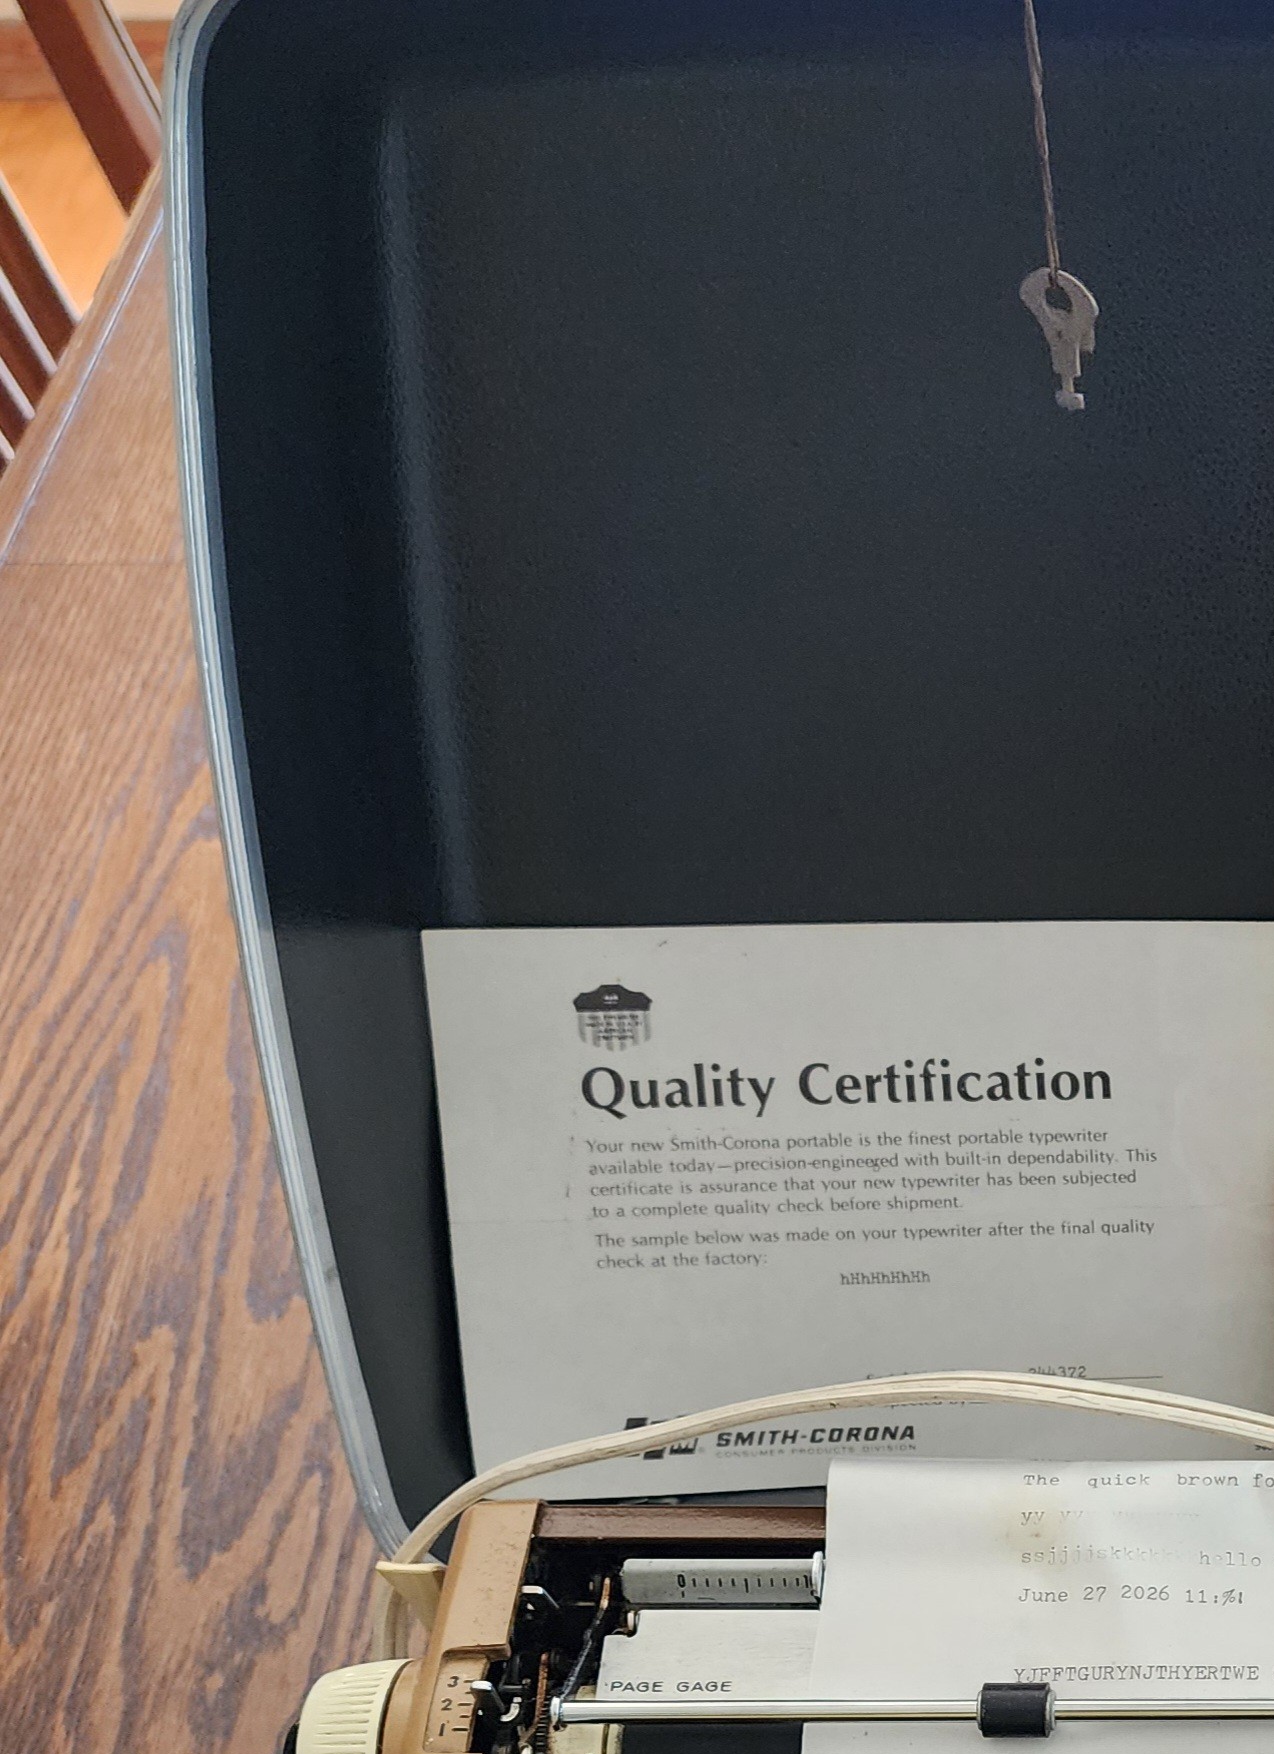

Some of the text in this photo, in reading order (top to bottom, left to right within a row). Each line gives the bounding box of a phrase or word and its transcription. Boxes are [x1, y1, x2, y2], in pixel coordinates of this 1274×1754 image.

[582, 1058, 1111, 1119] Quality Certification
[584, 1128, 1109, 1154] Your new Smith-Corona portable is the finest portable typewriter
[593, 1218, 1155, 1248] The sample below was made on your typewriter after the final quality
[717, 1426, 914, 1447] SMITH-CORONA
[716, 1443, 917, 1459] CONSUMER PRODUCTS DIVISION
[1022, 1474, 1060, 1486] The
[1087, 1473, 1151, 1490] quick
[1176, 1473, 1240, 1487] brown
[1018, 1589, 1068, 1602] June
[1083, 1586, 1106, 1602] 27
[1121, 1585, 1169, 1601] 2026
[611, 1681, 731, 1692] PAGE GAGE
